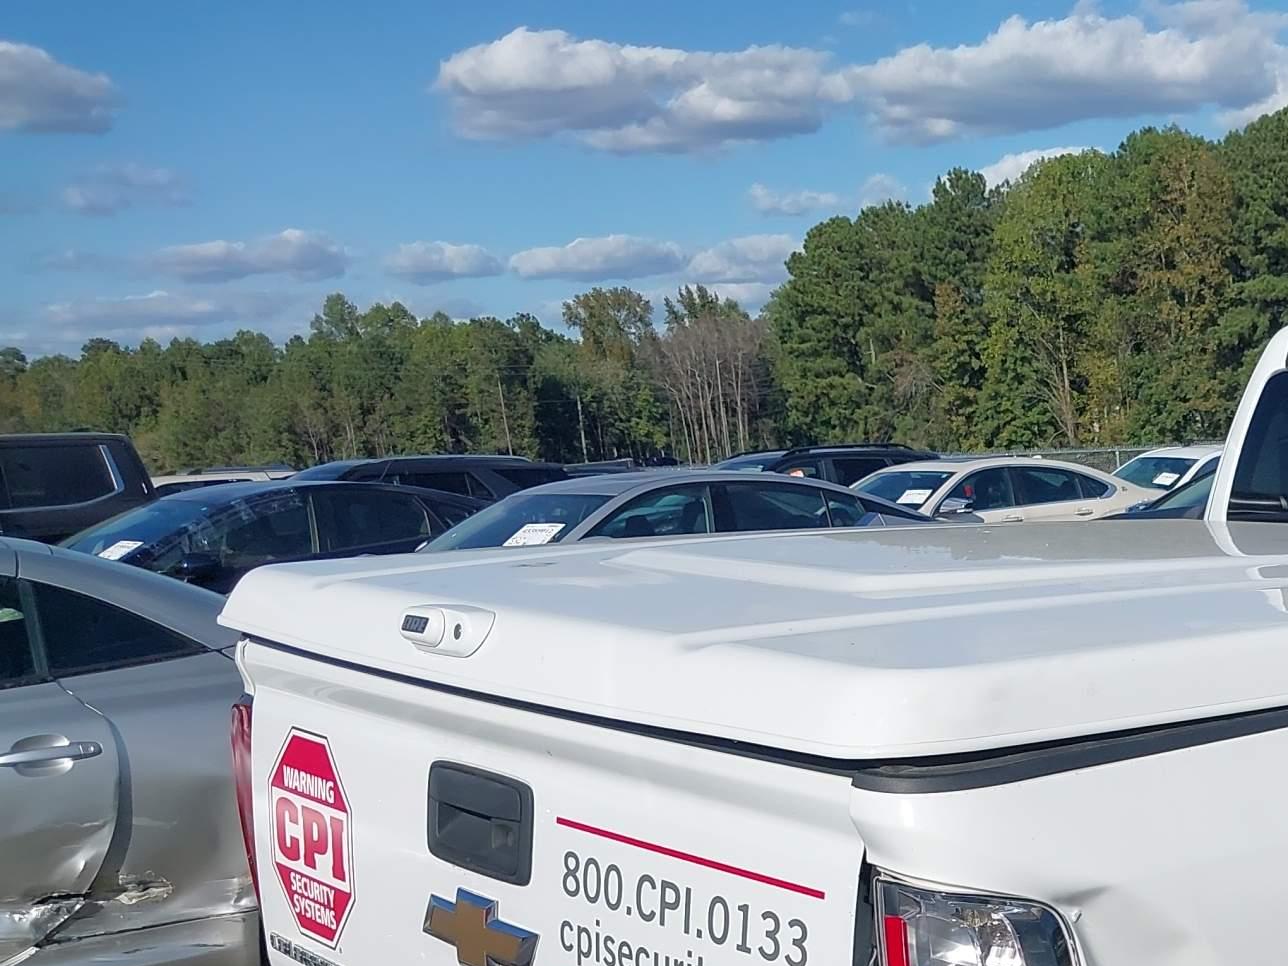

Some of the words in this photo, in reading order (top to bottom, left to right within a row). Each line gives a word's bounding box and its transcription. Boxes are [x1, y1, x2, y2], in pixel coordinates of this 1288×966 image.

[282, 764, 335, 804] WARNING
[275, 796, 346, 883] CPI
[289, 872, 336, 909] SECURITY
[293, 894, 337, 930] SYSTEMS
